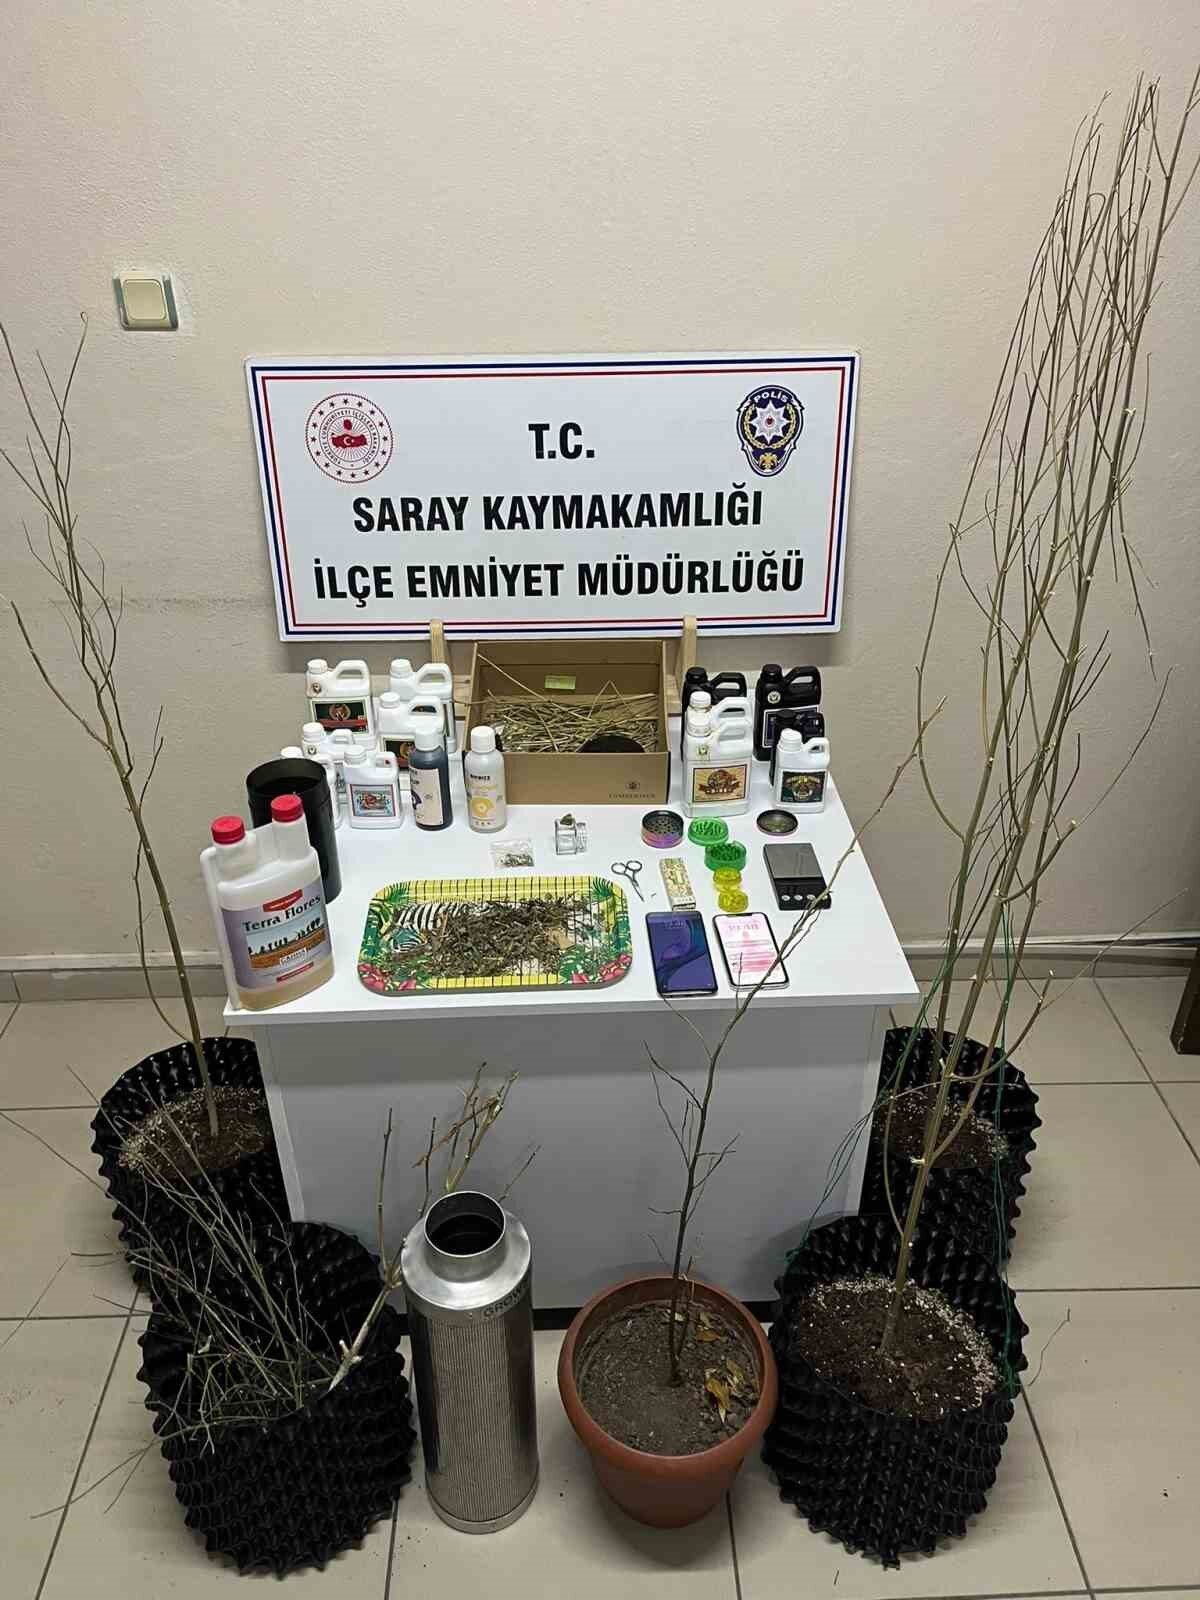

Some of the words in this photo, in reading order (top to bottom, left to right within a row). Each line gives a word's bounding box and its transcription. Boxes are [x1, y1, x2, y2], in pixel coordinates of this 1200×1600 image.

[754, 391, 788, 403] POLİS
[528, 422, 595, 459] T.C.
[352, 496, 469, 532] SARAY
[482, 482, 762, 531] KAYMAKAMLIĞI
[314, 558, 394, 608] İLÇE
[406, 556, 564, 598] EMNİYET
[578, 549, 804, 596] MÜDÜRLÜĞÜ
[243, 917, 281, 932] Terra
[285, 896, 321, 919] Flores
